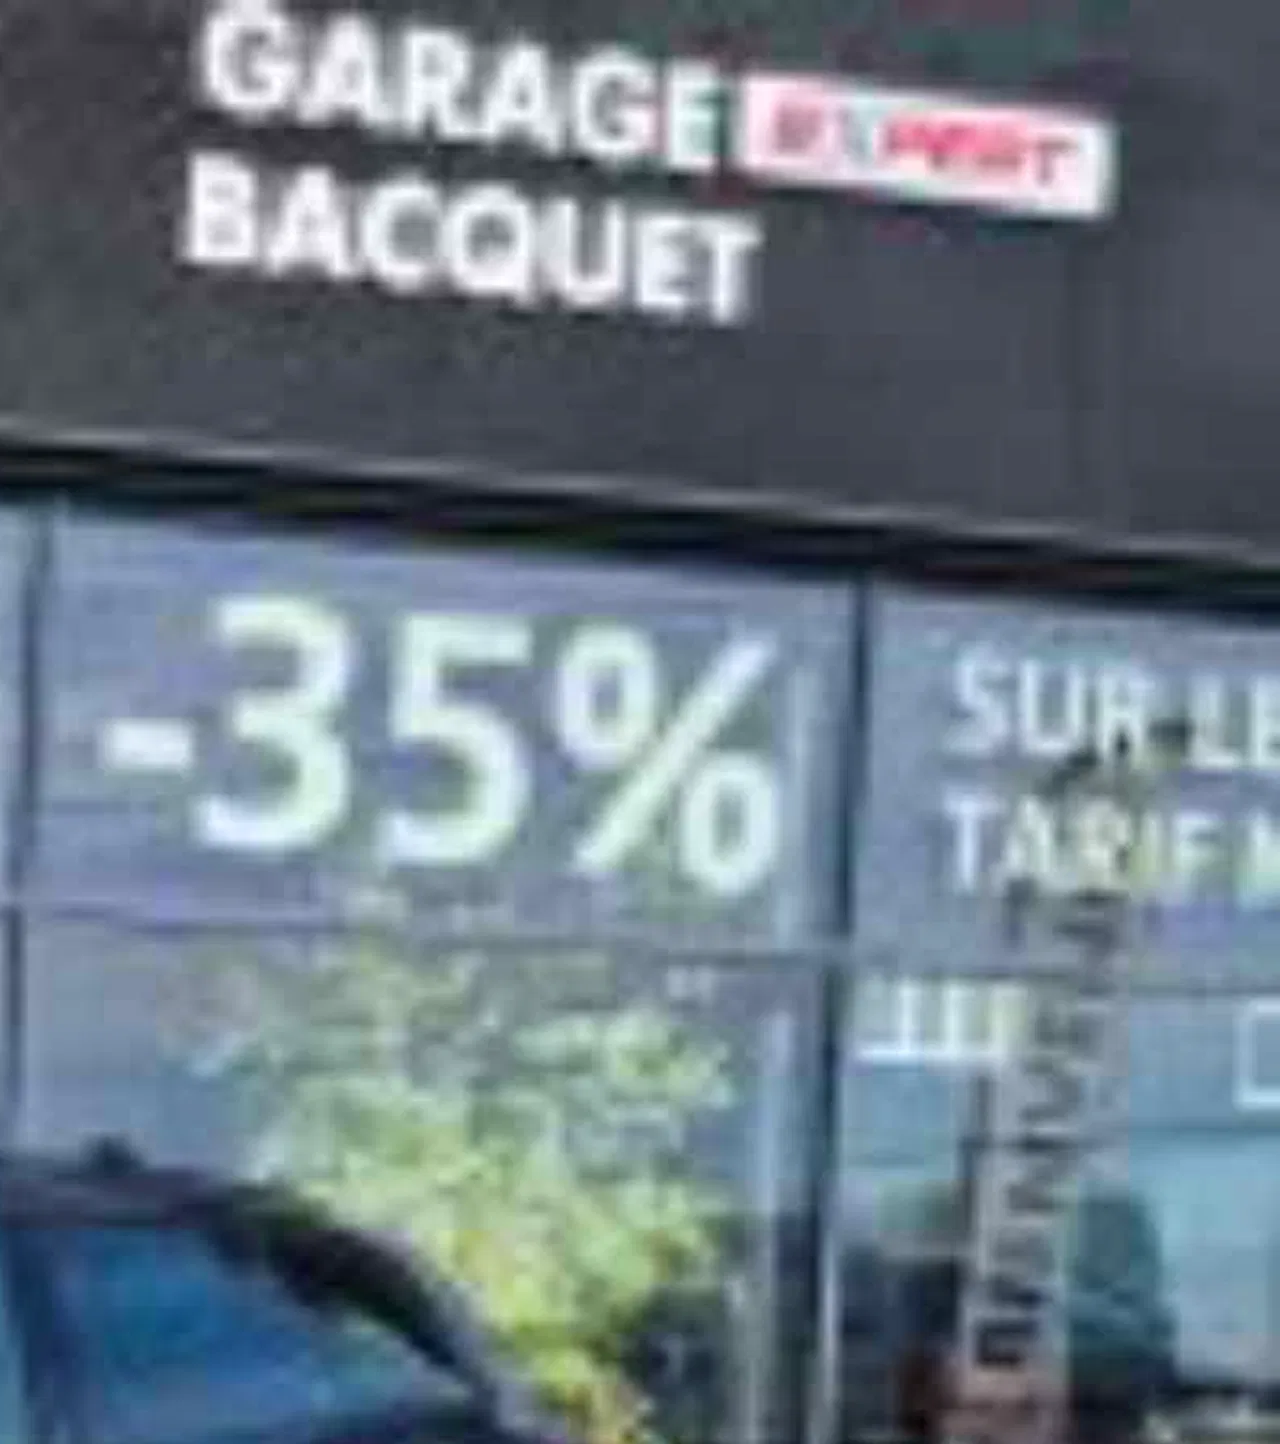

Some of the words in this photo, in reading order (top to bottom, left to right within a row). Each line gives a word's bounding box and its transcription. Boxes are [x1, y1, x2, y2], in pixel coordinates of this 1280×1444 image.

[201, 2, 724, 170] GARAGE
[184, 152, 762, 322] BACQUET
[99, 596, 780, 894] -35%
[948, 647, 1154, 762] SUR
